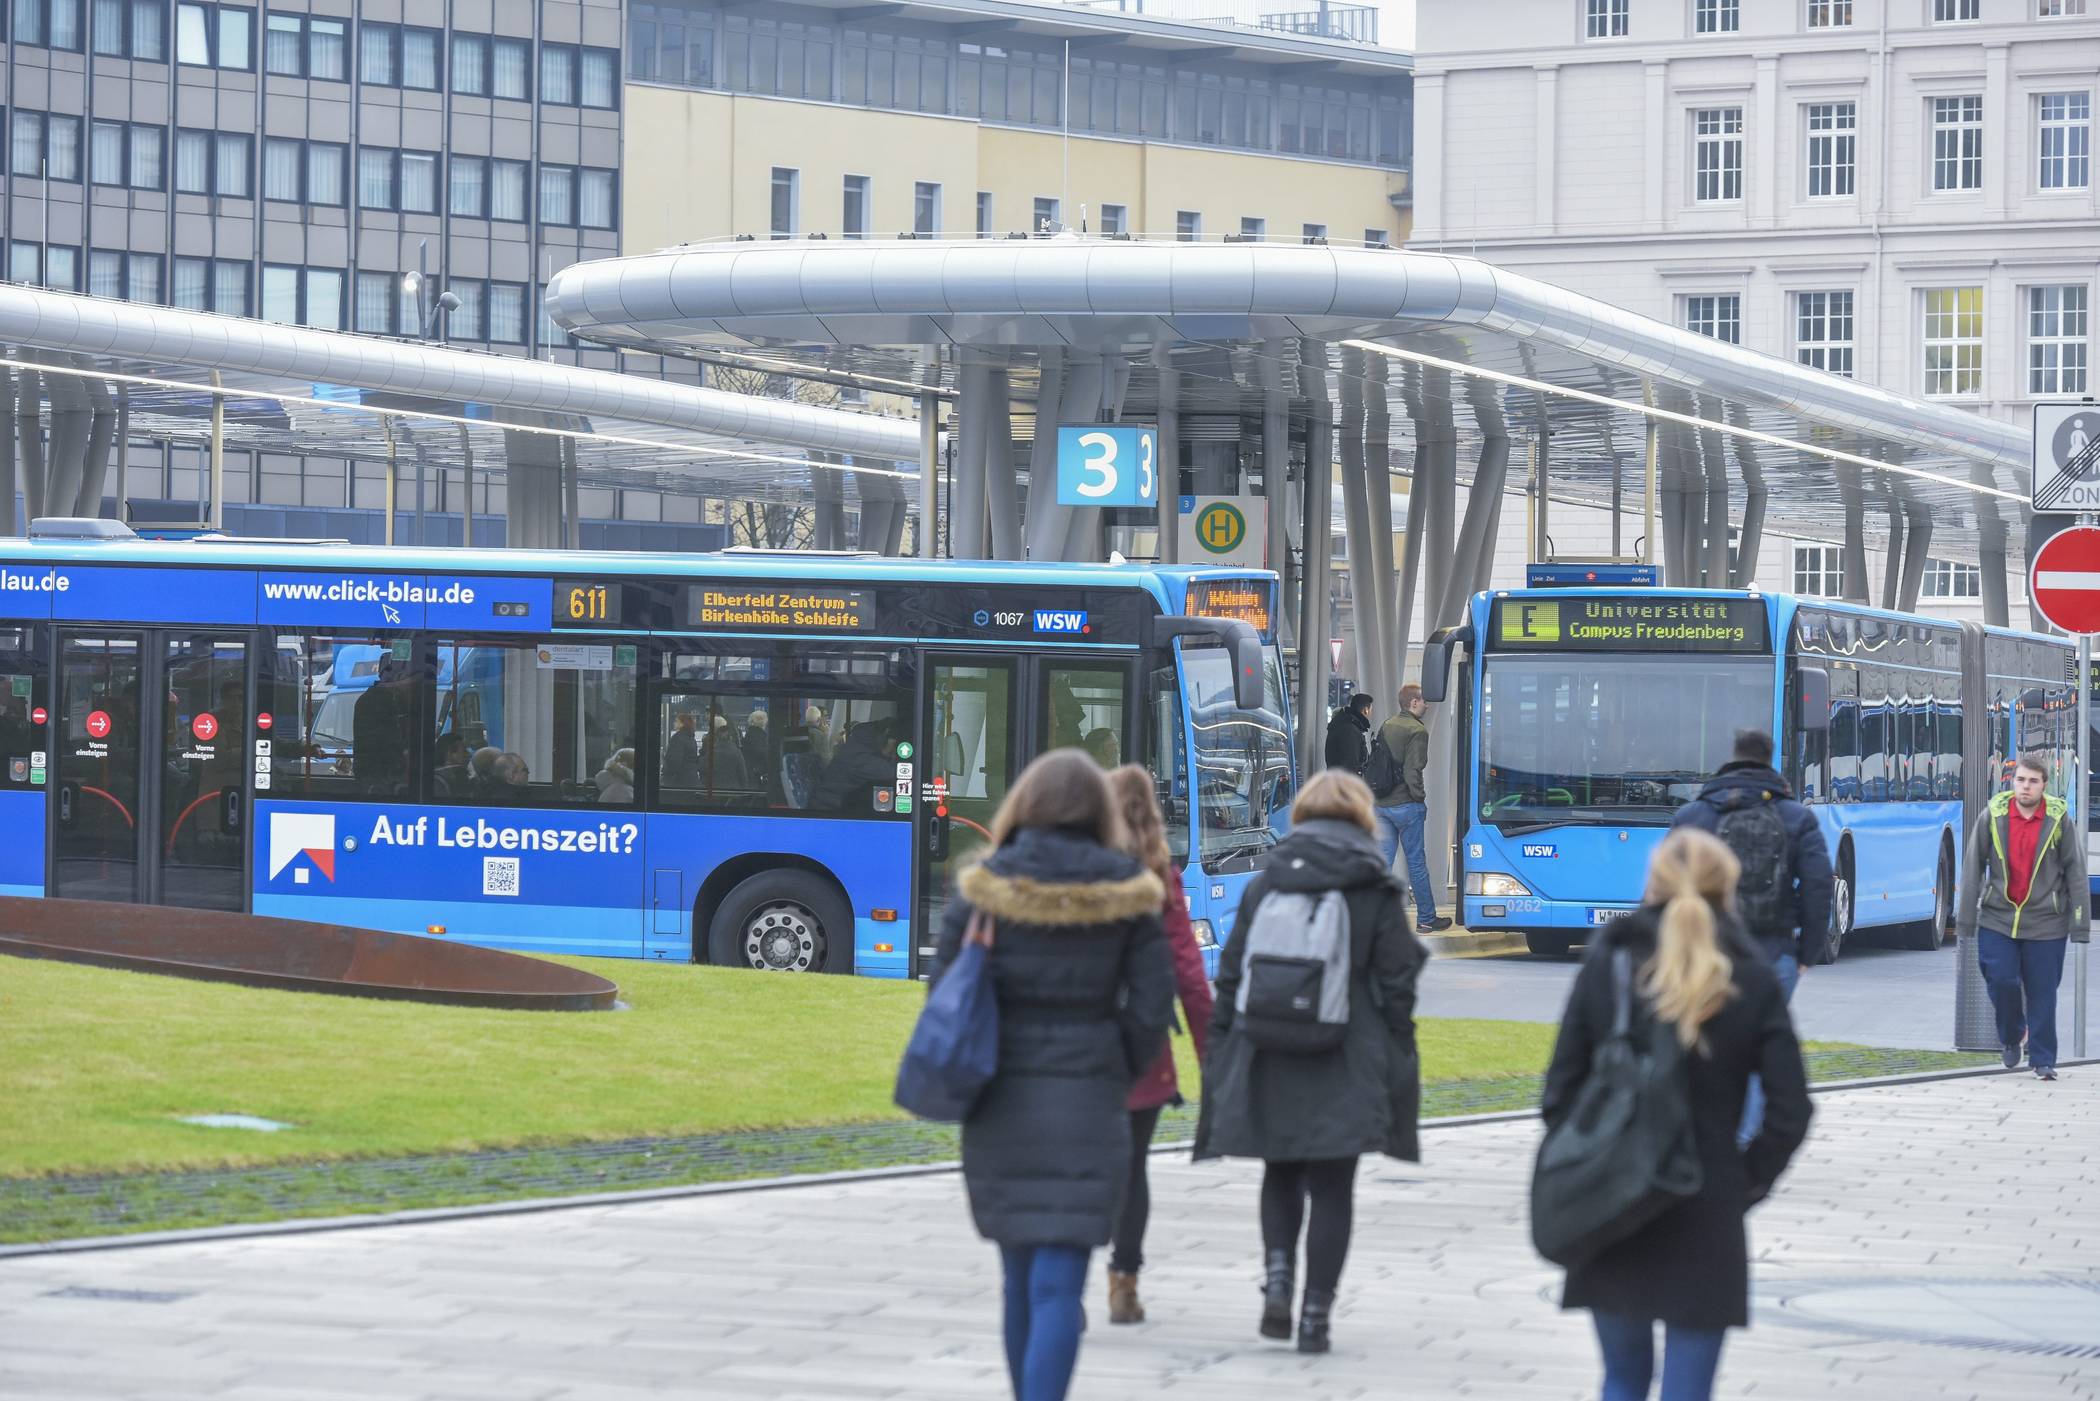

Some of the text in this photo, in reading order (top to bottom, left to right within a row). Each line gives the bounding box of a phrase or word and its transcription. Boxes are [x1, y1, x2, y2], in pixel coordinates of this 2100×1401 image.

[1076, 432, 1118, 497] 3
[1140, 433, 1153, 498] 3
[2060, 486, 2100, 504] ZON
[1183, 500, 1191, 509] 3
[1209, 513, 1231, 543] H
[0, 569, 70, 592] lau.de
[1631, 576, 1651, 584] Abfahrt
[264, 580, 475, 604] www.click-blau.de
[703, 592, 775, 608] Elberfeld
[778, 594, 846, 610] Zentrum
[570, 588, 606, 619] 611
[1585, 602, 1728, 618] Universität
[701, 608, 860, 626] Birkenhöhe Schleife
[993, 612, 1025, 626] 1067
[1036, 613, 1082, 630] WSW
[1521, 605, 1537, 638] E
[1569, 622, 1745, 642] Campus Freudenberg
[76, 749, 108, 758] einsteigen
[182, 752, 215, 761] einsteigen
[369, 815, 639, 854] Auf Lebenszeit?
[1523, 845, 1554, 857] WSW
[1506, 900, 1542, 913] 0262
[1599, 911, 1607, 923] W
